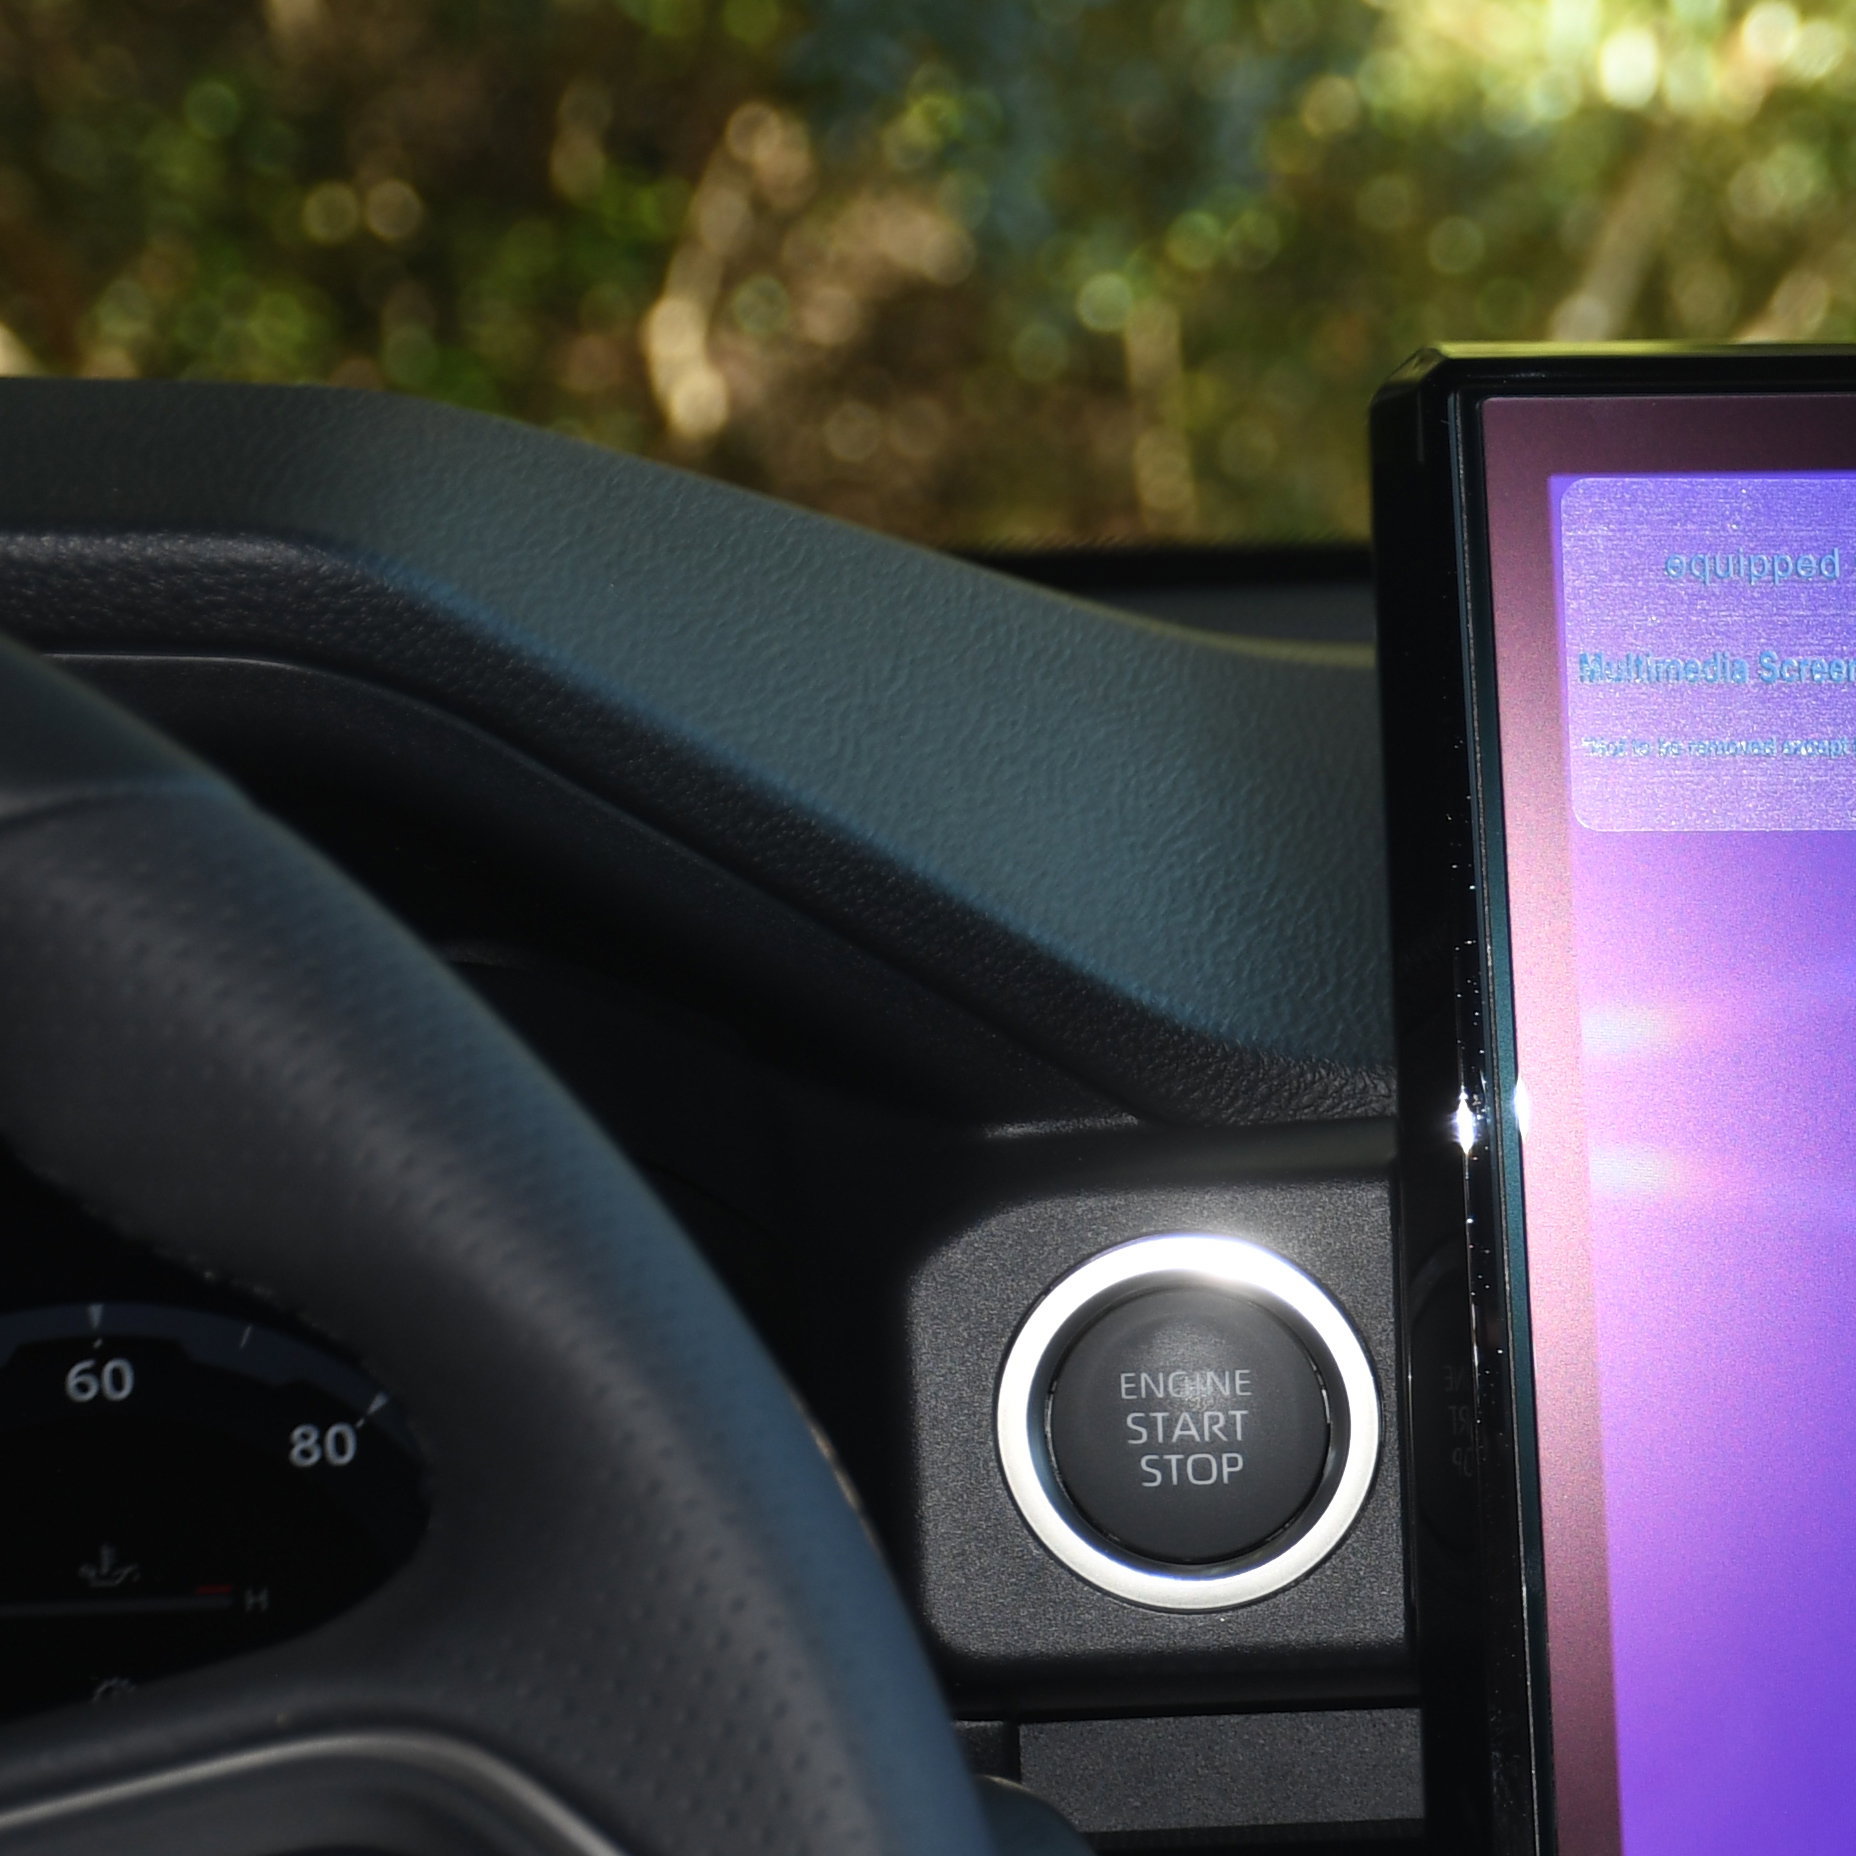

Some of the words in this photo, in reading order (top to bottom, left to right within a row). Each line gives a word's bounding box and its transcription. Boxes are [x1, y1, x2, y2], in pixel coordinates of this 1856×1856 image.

[1664, 548, 1840, 586] equipped
[1578, 652, 1749, 684] Multimedia
[1781, 737, 1850, 758] except
[65, 1357, 136, 1403] 60
[1119, 1368, 1253, 1400] ENGINE
[288, 1421, 358, 1468] 80
[1126, 1410, 1249, 1446] START
[1140, 1452, 1245, 1488] STOP
